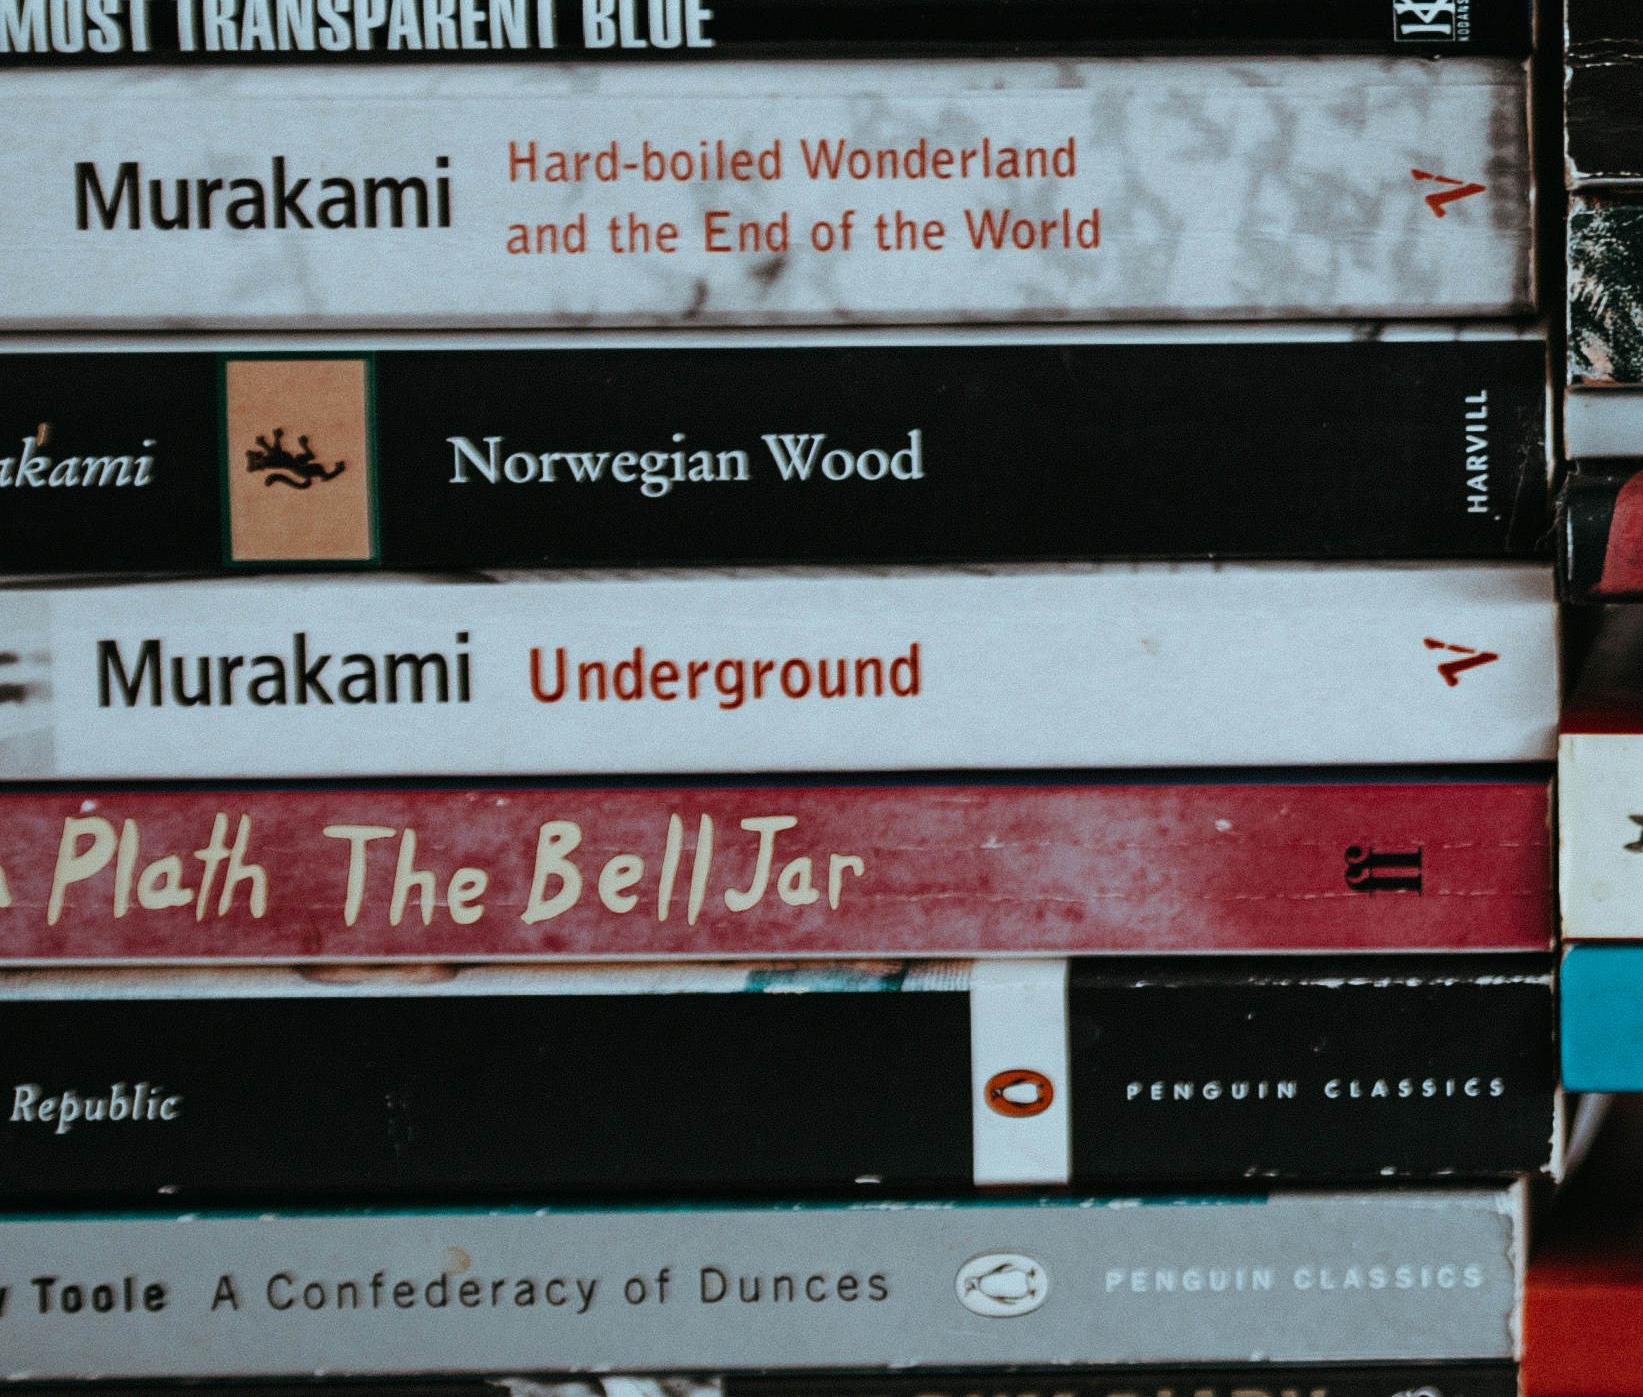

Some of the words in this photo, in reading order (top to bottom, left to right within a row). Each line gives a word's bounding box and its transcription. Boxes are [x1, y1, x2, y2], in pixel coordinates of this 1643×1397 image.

[75, 156, 451, 231] Murakami
[509, 139, 782, 183] Hard-boiled
[800, 137, 1076, 180] Wonderland
[506, 213, 587, 255] and
[608, 212, 680, 254] the
[704, 211, 790, 252] End
[810, 209, 855, 253] of
[874, 210, 946, 252] the
[964, 208, 1100, 250] World
[447, 433, 749, 498] Norwegian
[761, 429, 924, 481] Wood
[1465, 390, 1488, 513] HARVILL
[97, 631, 471, 708] Murakami
[530, 642, 921, 710] Underground
[10, 1083, 179, 1135] Republic
